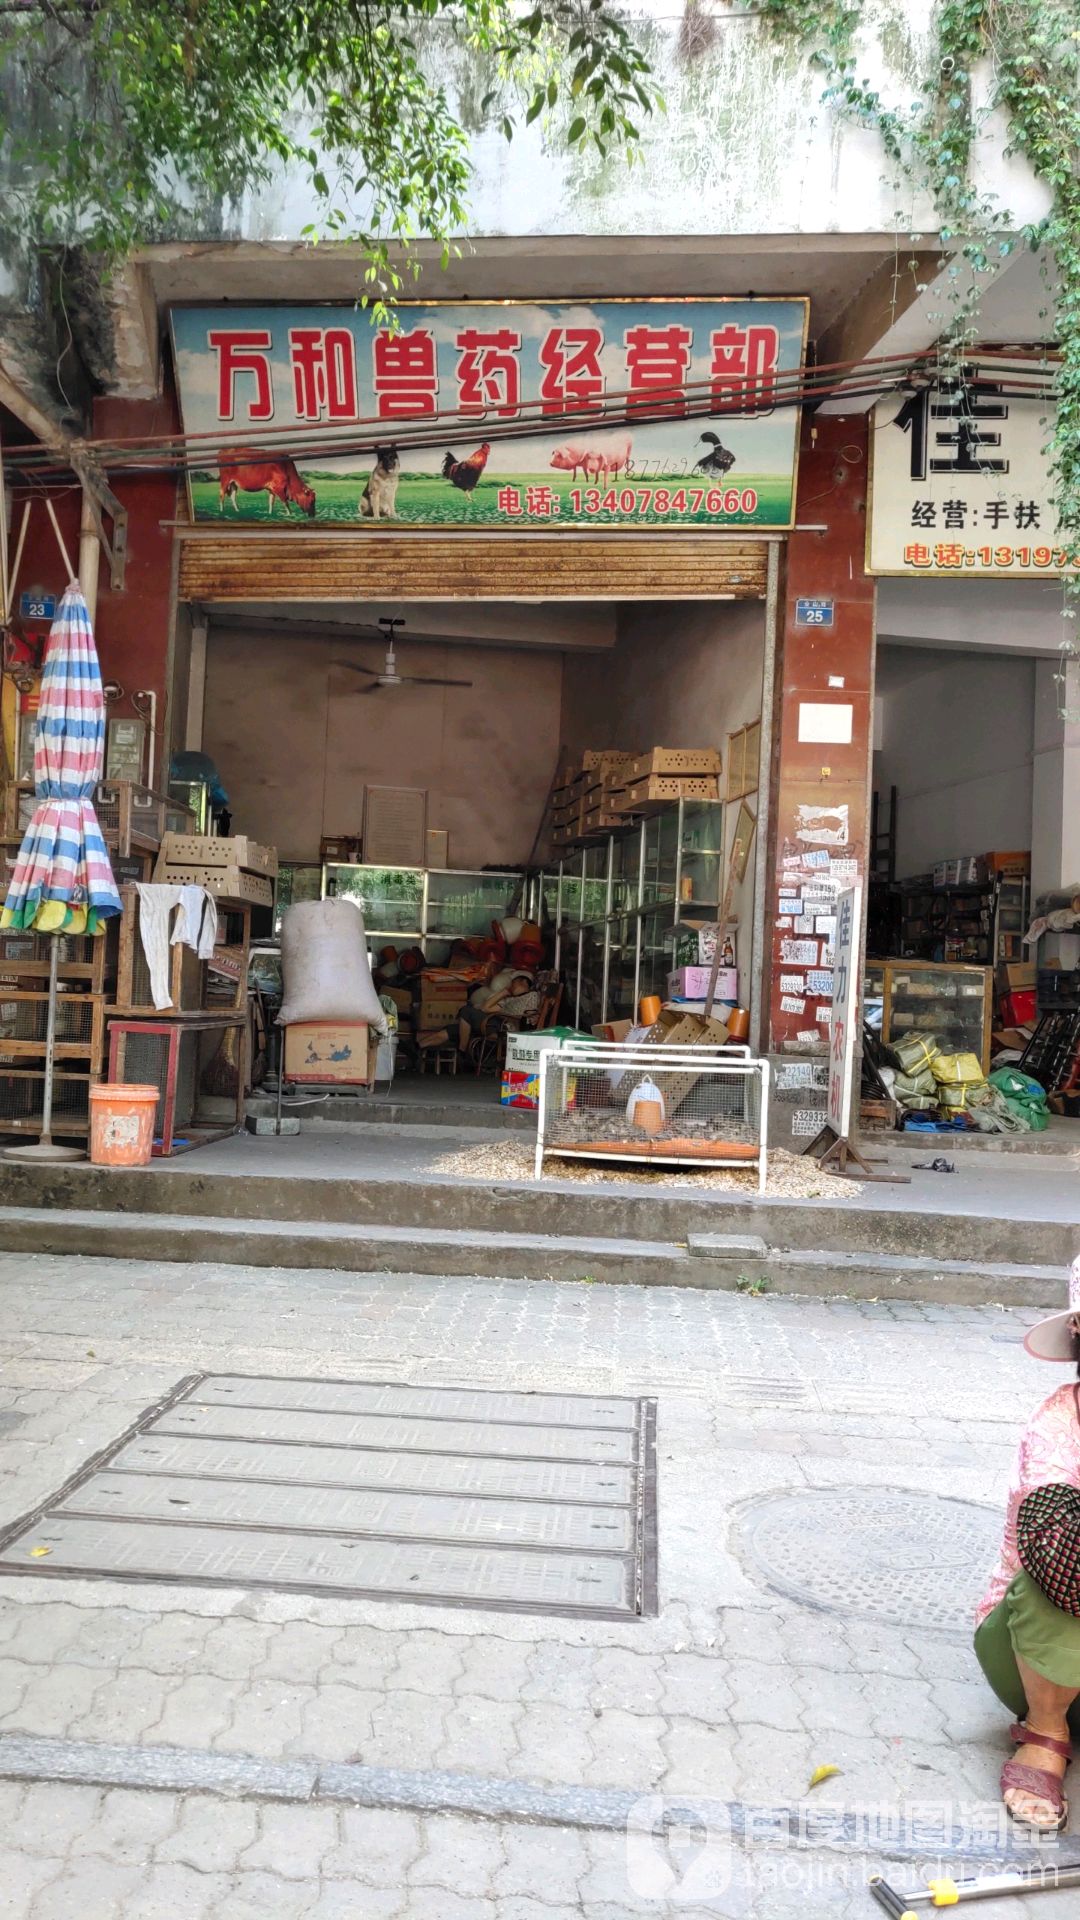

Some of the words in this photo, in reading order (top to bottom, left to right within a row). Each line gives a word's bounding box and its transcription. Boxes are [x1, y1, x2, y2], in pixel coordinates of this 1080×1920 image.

[207, 324, 780, 421] 万和兽药经营部
[29, 603, 45, 616] 23
[806, 610, 823, 623] 25
